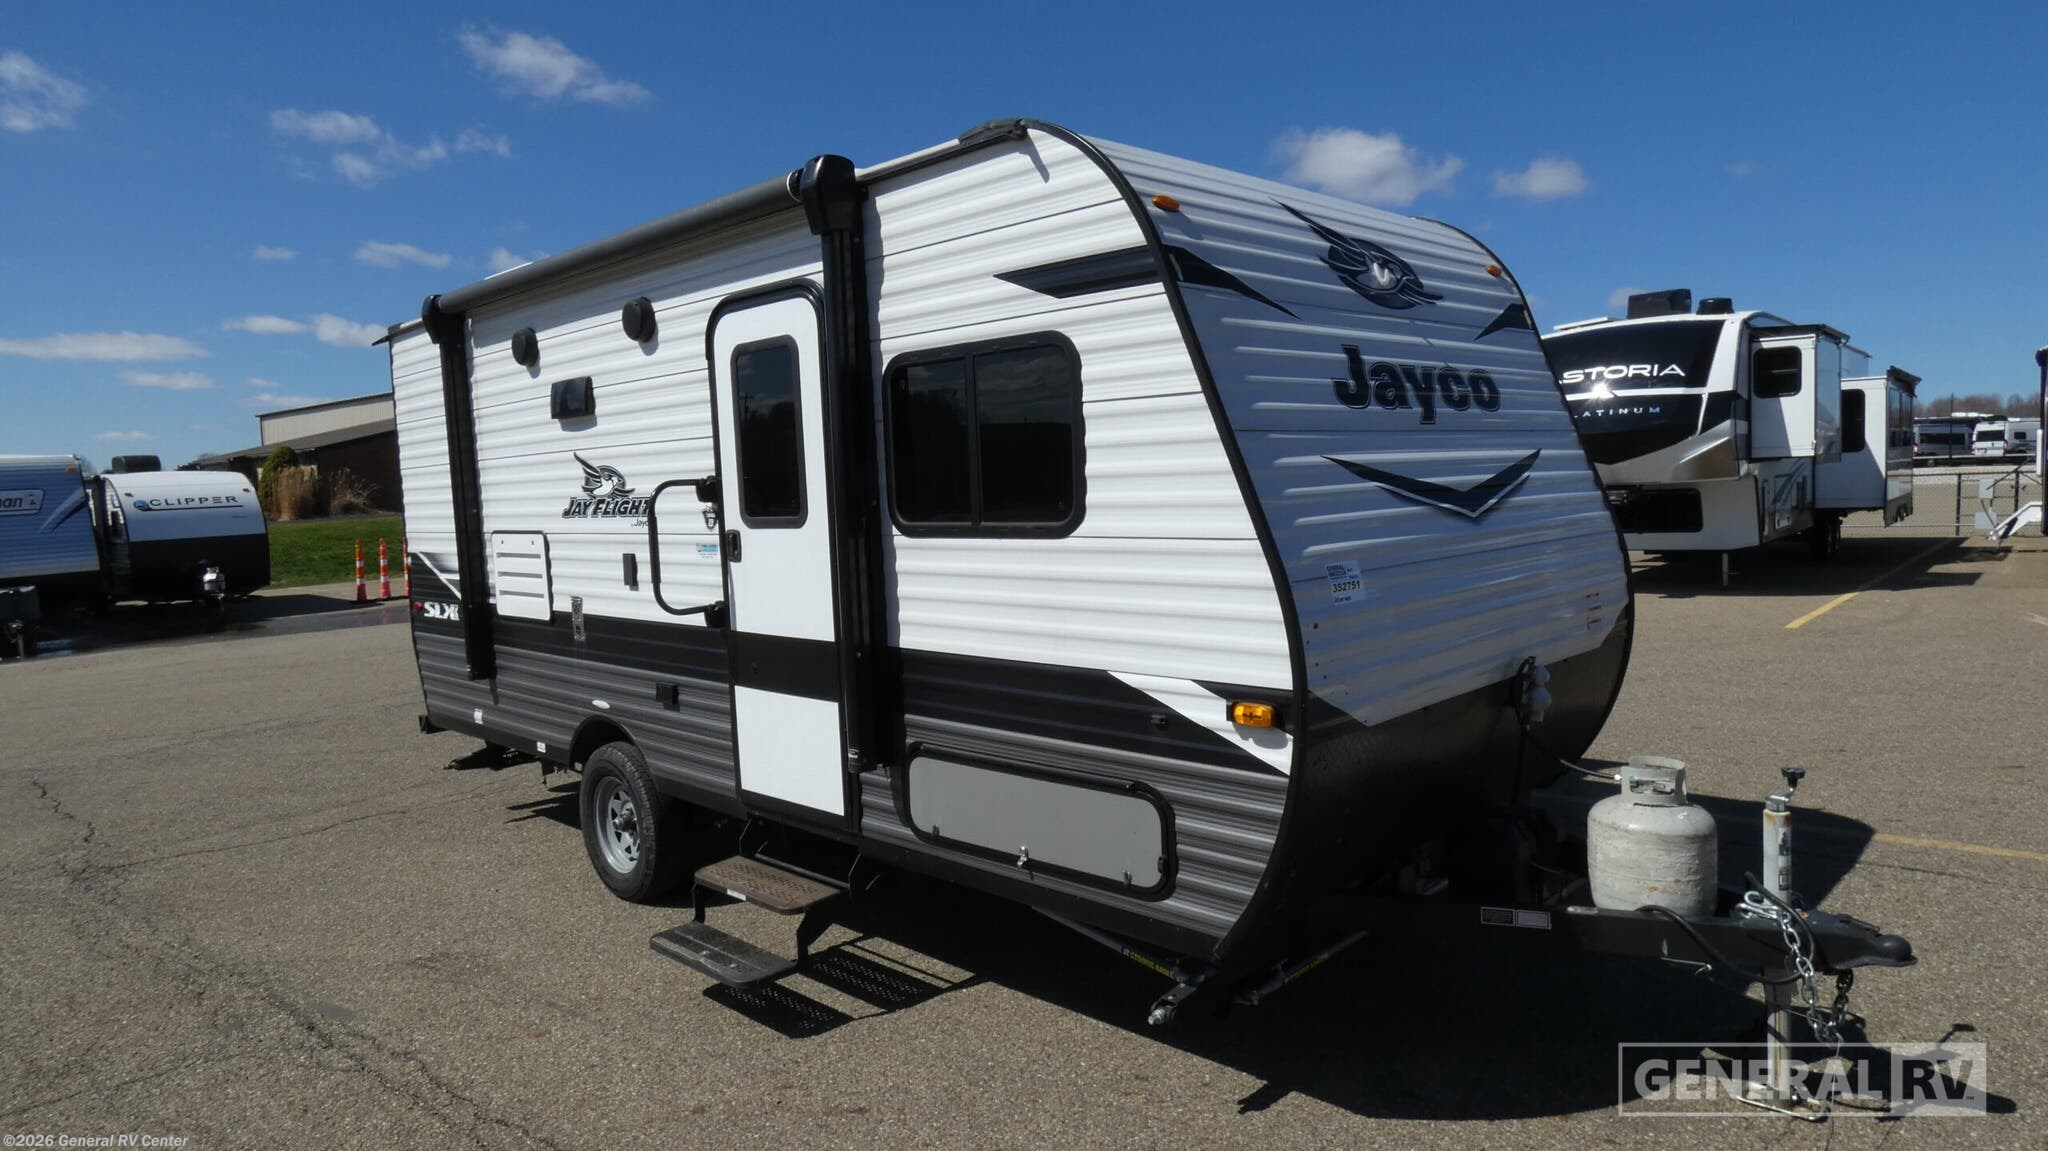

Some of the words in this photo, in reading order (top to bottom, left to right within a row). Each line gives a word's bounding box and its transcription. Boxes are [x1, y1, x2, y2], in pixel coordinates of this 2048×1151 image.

[1559, 364, 1686, 384] STORIA
[1330, 344, 1501, 425] Jayco
[1573, 406, 1661, 418] ATINUM
[0, 497, 23, 508] an
[149, 495, 238, 506] CLIPPER
[562, 497, 593, 518] JAY
[1332, 580, 1361, 593] 352751
